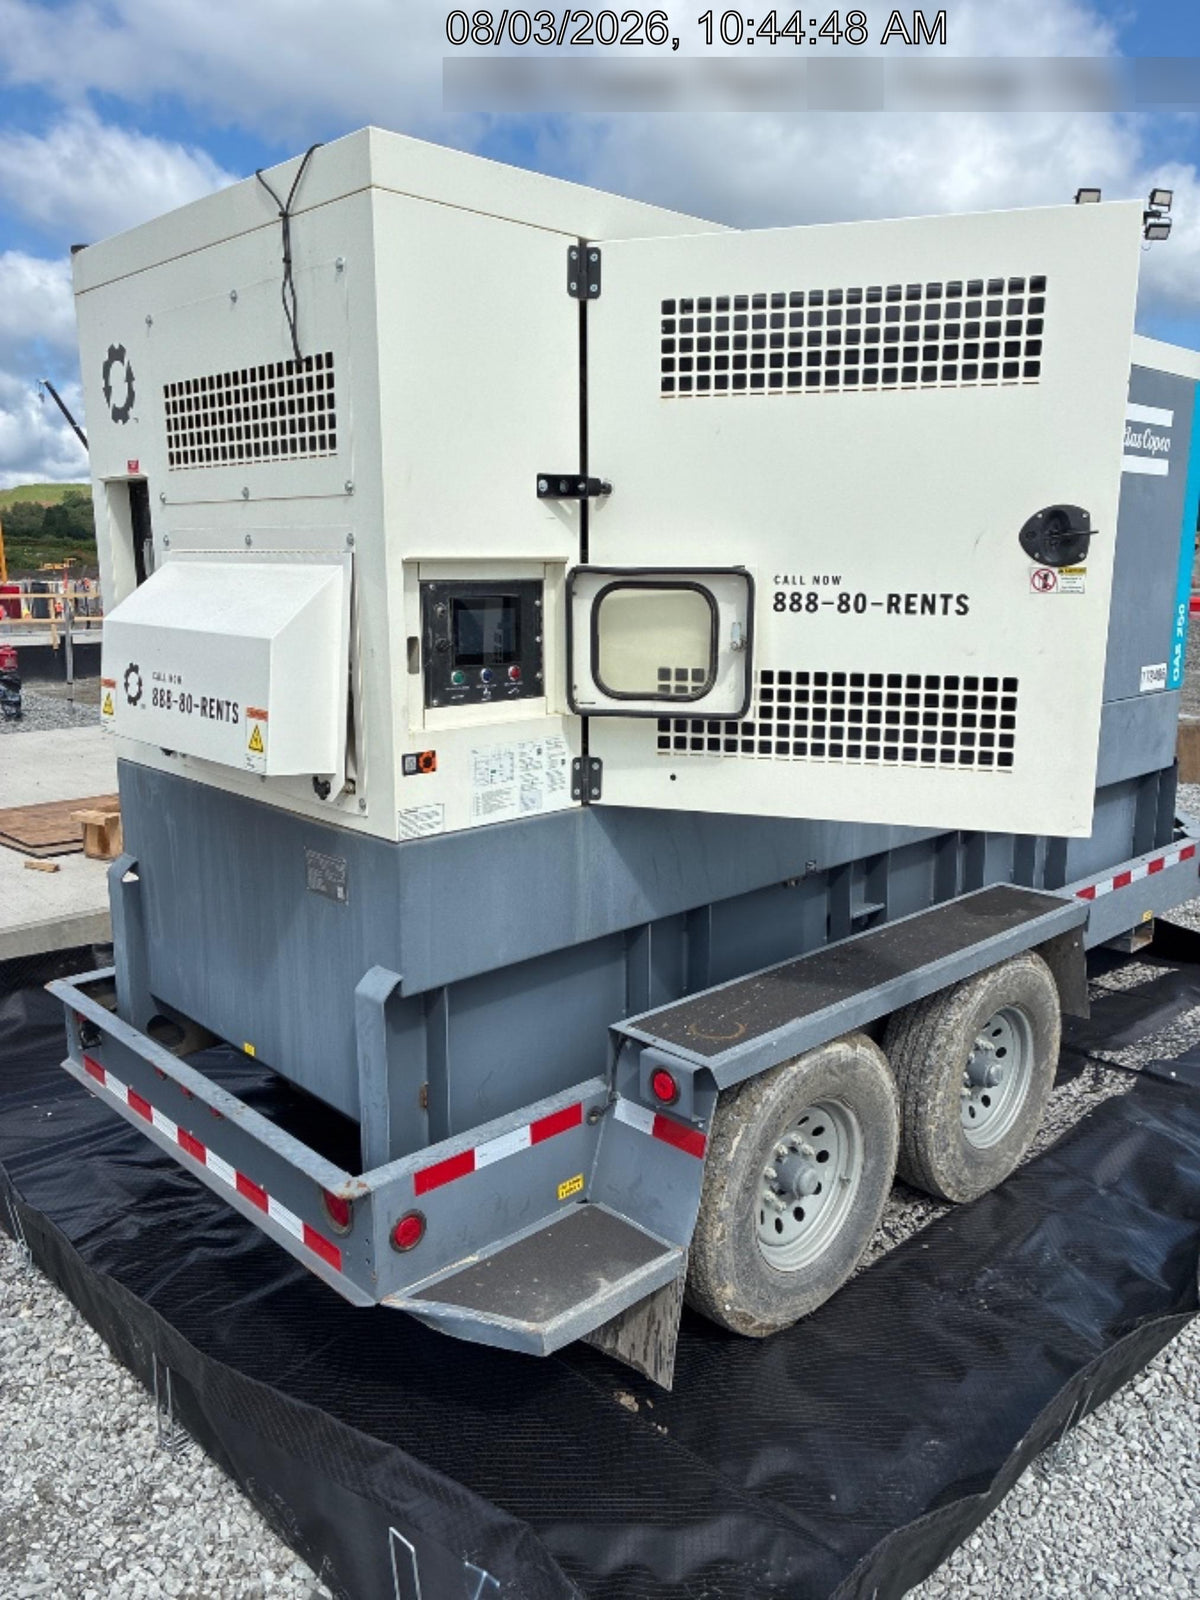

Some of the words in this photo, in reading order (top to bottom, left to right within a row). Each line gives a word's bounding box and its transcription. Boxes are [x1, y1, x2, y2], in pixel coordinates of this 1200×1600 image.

[1143, 428, 1171, 455] Copco
[773, 575, 806, 586] CALL
[812, 575, 842, 586] NOW
[773, 592, 970, 616] 888-80-RENTS
[152, 687, 239, 724] 888-80-RENTS
